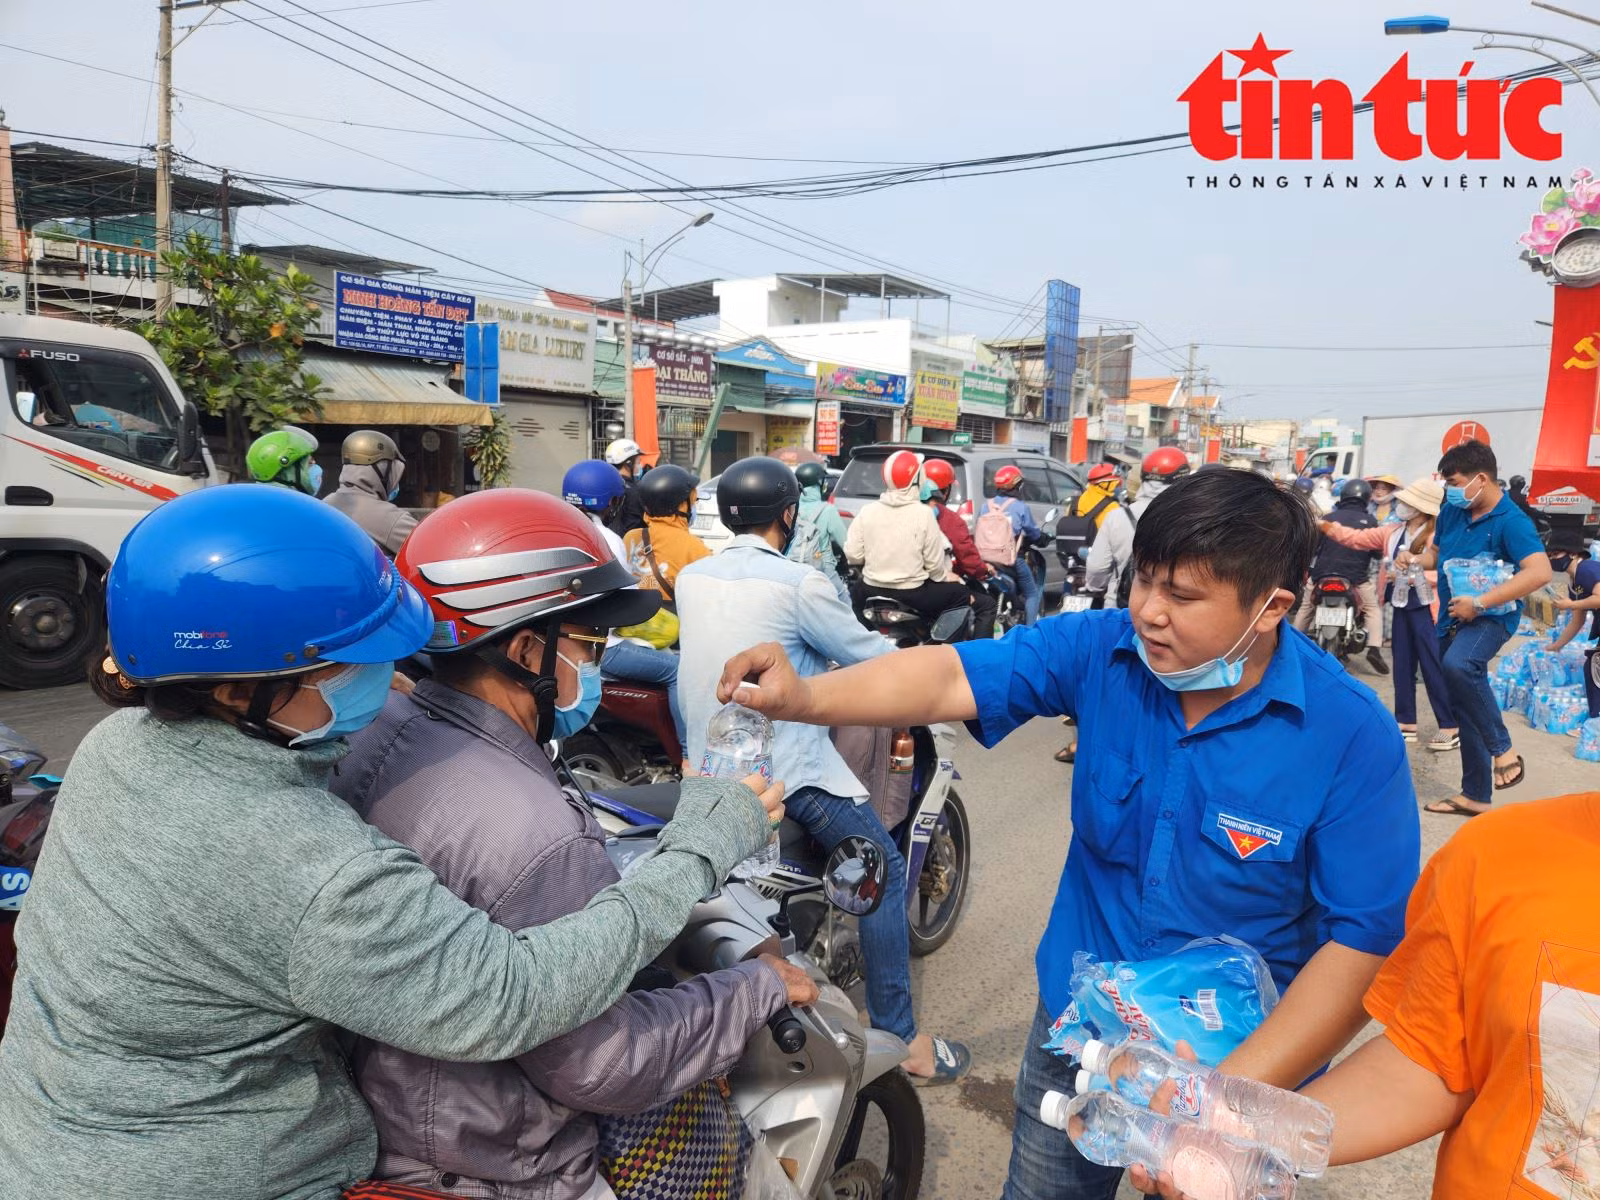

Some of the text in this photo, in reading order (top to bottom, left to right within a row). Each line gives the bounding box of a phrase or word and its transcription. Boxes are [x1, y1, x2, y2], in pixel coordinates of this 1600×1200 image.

[340, 275, 353, 283] CƠ
[366, 279, 381, 288] GIA
[381, 282, 404, 292] CÔNG
[342, 287, 377, 308] MINH
[377, 293, 421, 315] HOÀNG
[421, 298, 445, 319] TẤN
[30, 350, 80, 362] FUSO
[656, 350, 666, 360] CƠ
[666, 350, 675, 361] SỞ
[675, 351, 687, 363] SẮT
[673, 364, 708, 384] THẮNG
[96, 465, 154, 489] CANTER
[1219, 817, 1239, 829] THANH
[1252, 827, 1267, 837] VIỆT
[1265, 832, 1280, 841] NAM
